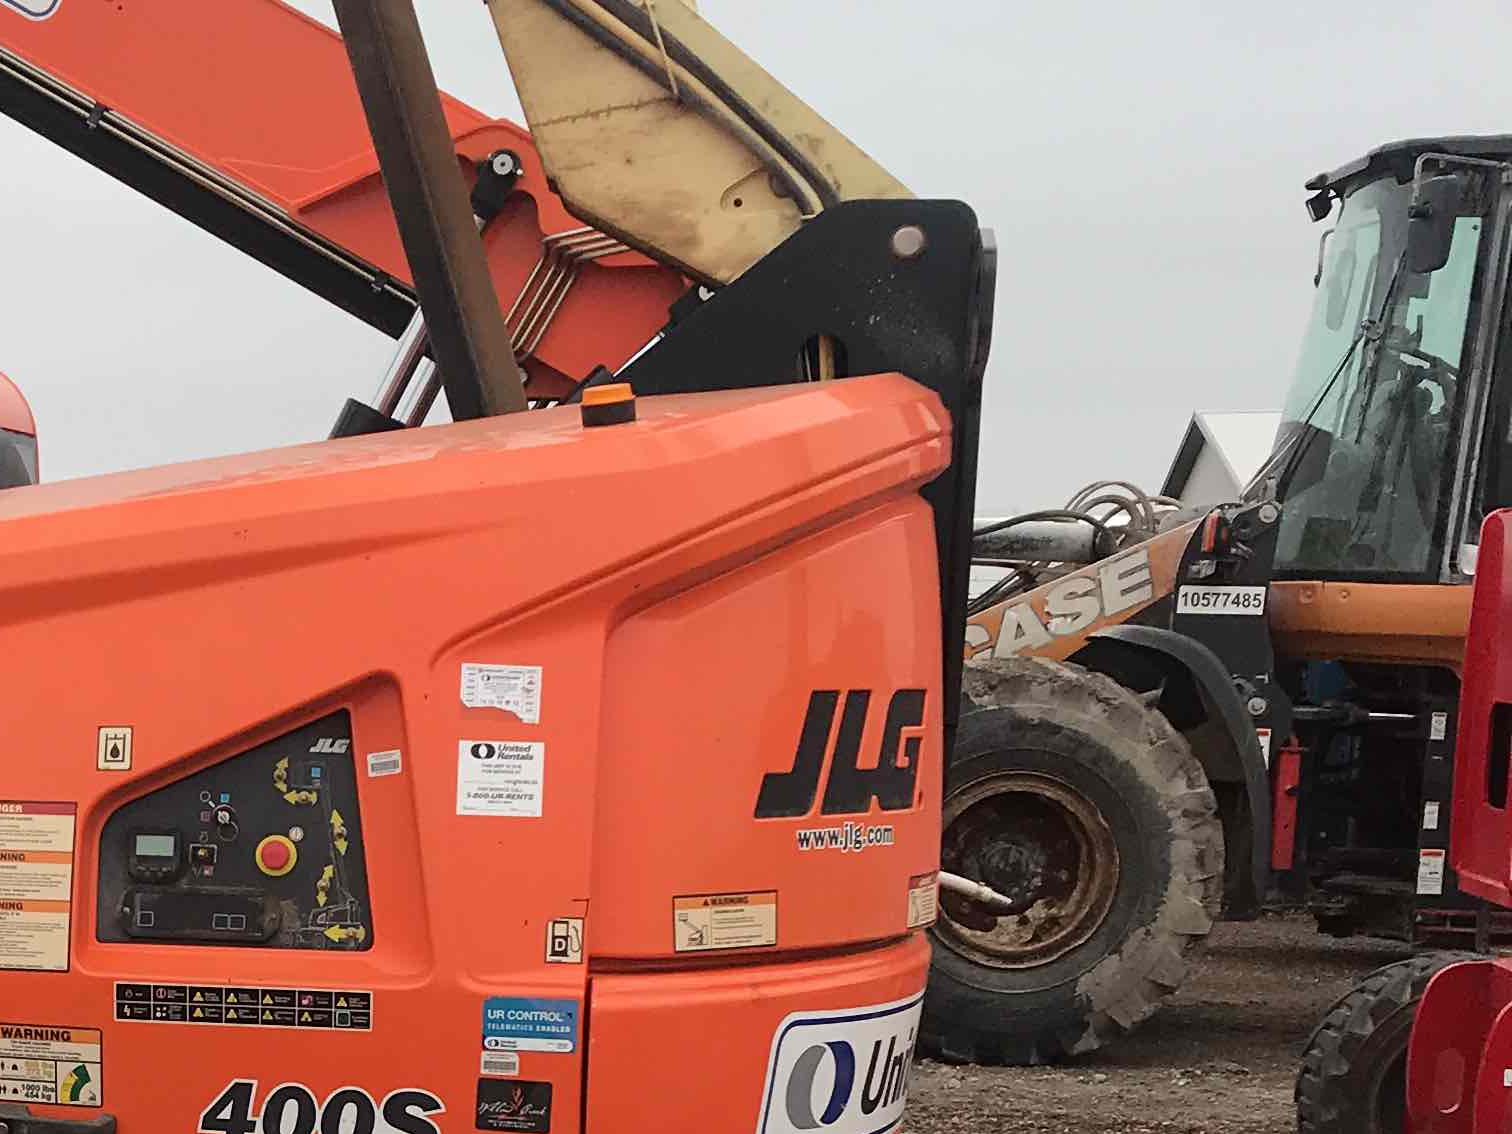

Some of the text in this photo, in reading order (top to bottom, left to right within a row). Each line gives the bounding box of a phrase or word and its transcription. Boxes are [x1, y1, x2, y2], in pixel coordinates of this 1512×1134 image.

[1181, 591, 1263, 609] 10577485
[309, 738, 350, 754] JLG
[498, 744, 532, 752] United
[497, 752, 534, 761] Rentals
[754, 689, 927, 819] JLG
[798, 824, 894, 851] www.jlg.com
[487, 1008, 565, 1022] UR CONTROL
[0, 1027, 72, 1042] WARNING
